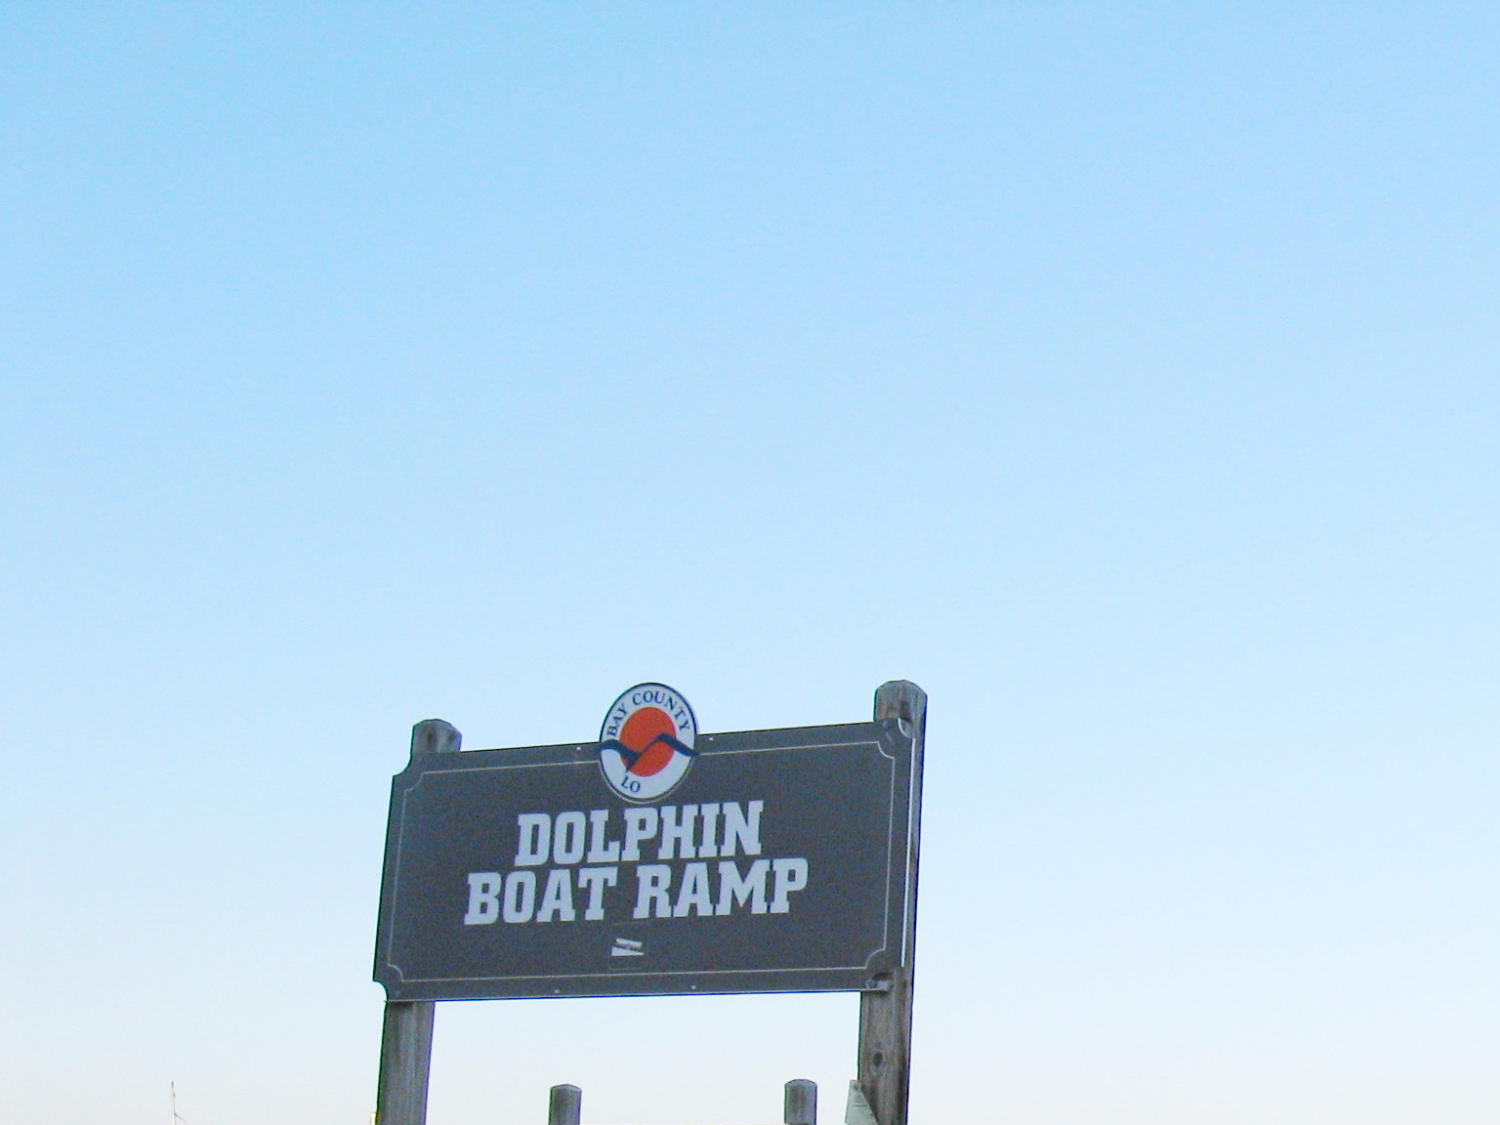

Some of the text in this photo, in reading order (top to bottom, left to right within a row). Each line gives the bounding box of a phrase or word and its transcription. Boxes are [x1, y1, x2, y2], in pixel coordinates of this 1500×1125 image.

[606, 690, 690, 737] BAY COUNTY
[514, 800, 763, 866] DOLPHIN
[464, 857, 809, 925] BOAT RAMP
